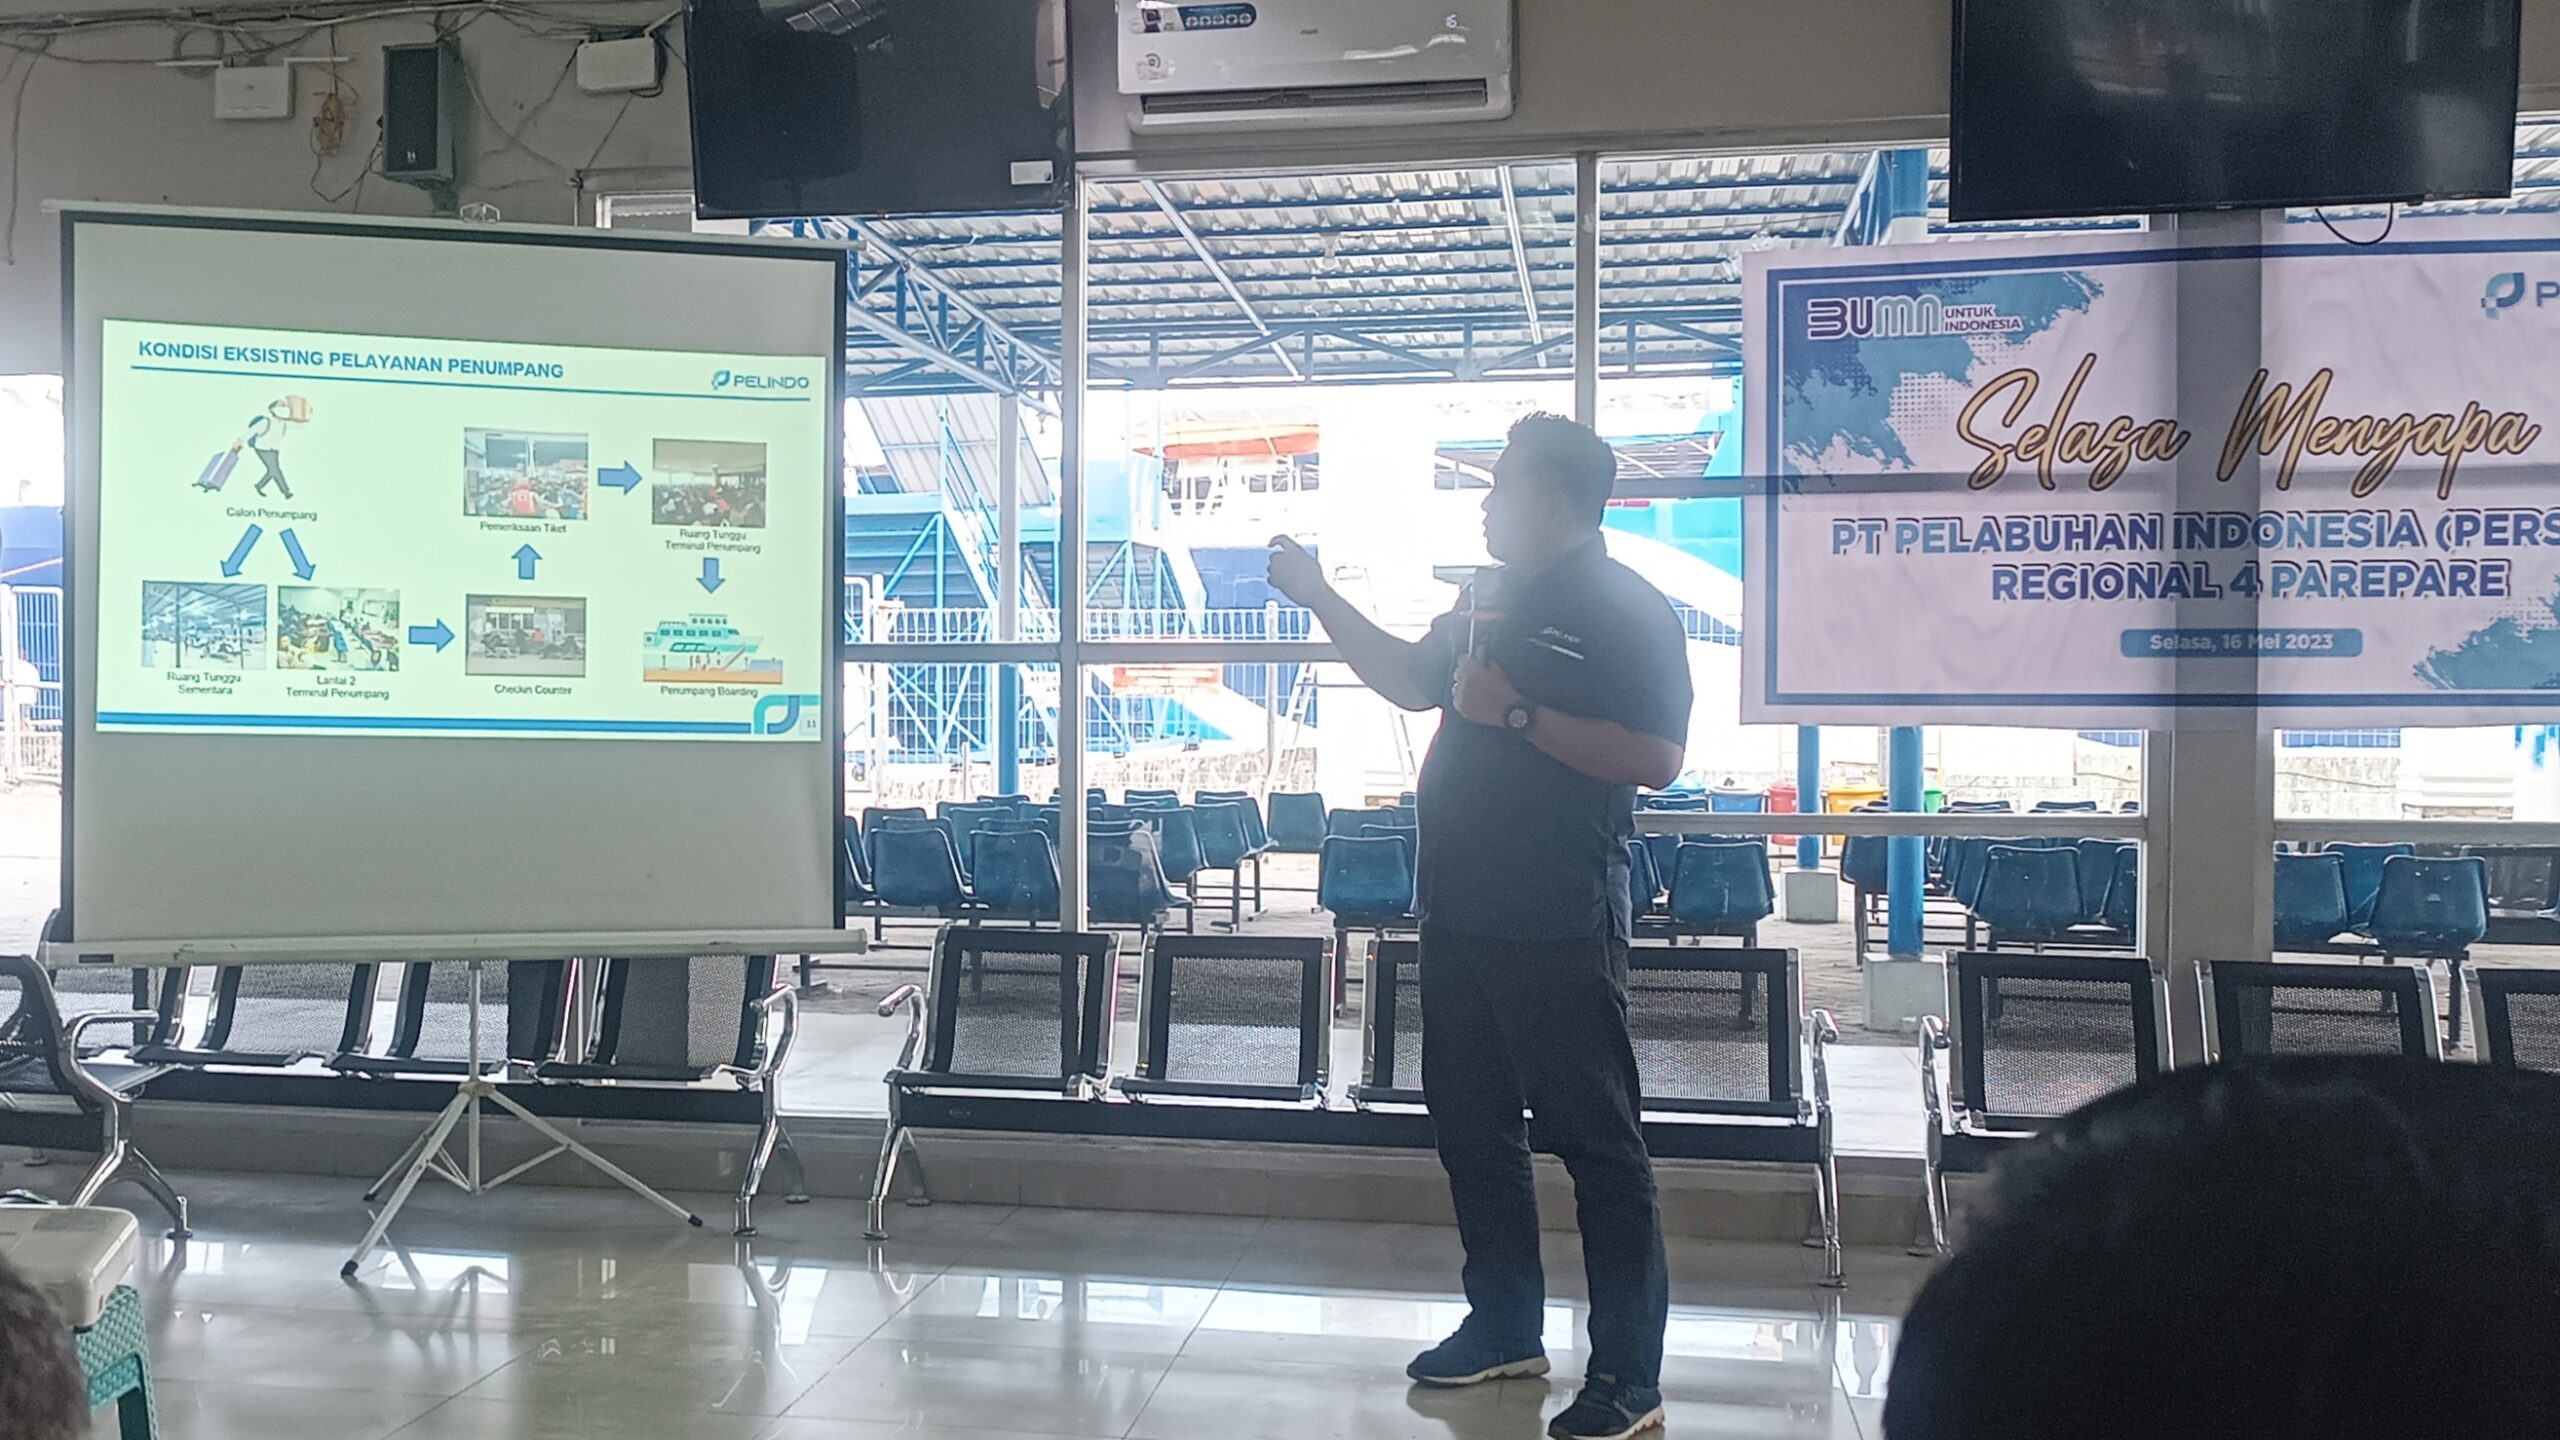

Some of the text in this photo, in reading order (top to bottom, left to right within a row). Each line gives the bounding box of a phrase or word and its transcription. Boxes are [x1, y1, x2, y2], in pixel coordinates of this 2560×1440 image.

[1945, 305, 1994, 319] UNTUK
[1945, 318, 2022, 332] INDONESIA
[138, 341, 564, 379] KONDISI EKSISTING PELAYANAN PENUMPANG
[734, 374, 810, 389] PELINDO
[1957, 352, 2542, 500] Selasa Menyapa
[226, 506, 318, 522] Calon Penumpang
[680, 528, 747, 542] Ruang Tunggu
[1832, 508, 2560, 555] PT PELABUHAN INDONESIA (PERS
[665, 540, 761, 554] Terminal Penumpang
[1992, 559, 2511, 600] REGIONAL 4 PAREPARE
[2150, 634, 2334, 652] Selasa, 16 Mei 2023
[167, 671, 242, 684] Ruang Tunggu
[316, 675, 356, 686] Lantai 2
[178, 684, 233, 695] Sementara
[286, 687, 390, 701] Terminal Penumpang
[535, 685, 572, 695] Counter
[660, 685, 759, 698] Penumpang Boarding
[806, 719, 817, 728] 11
